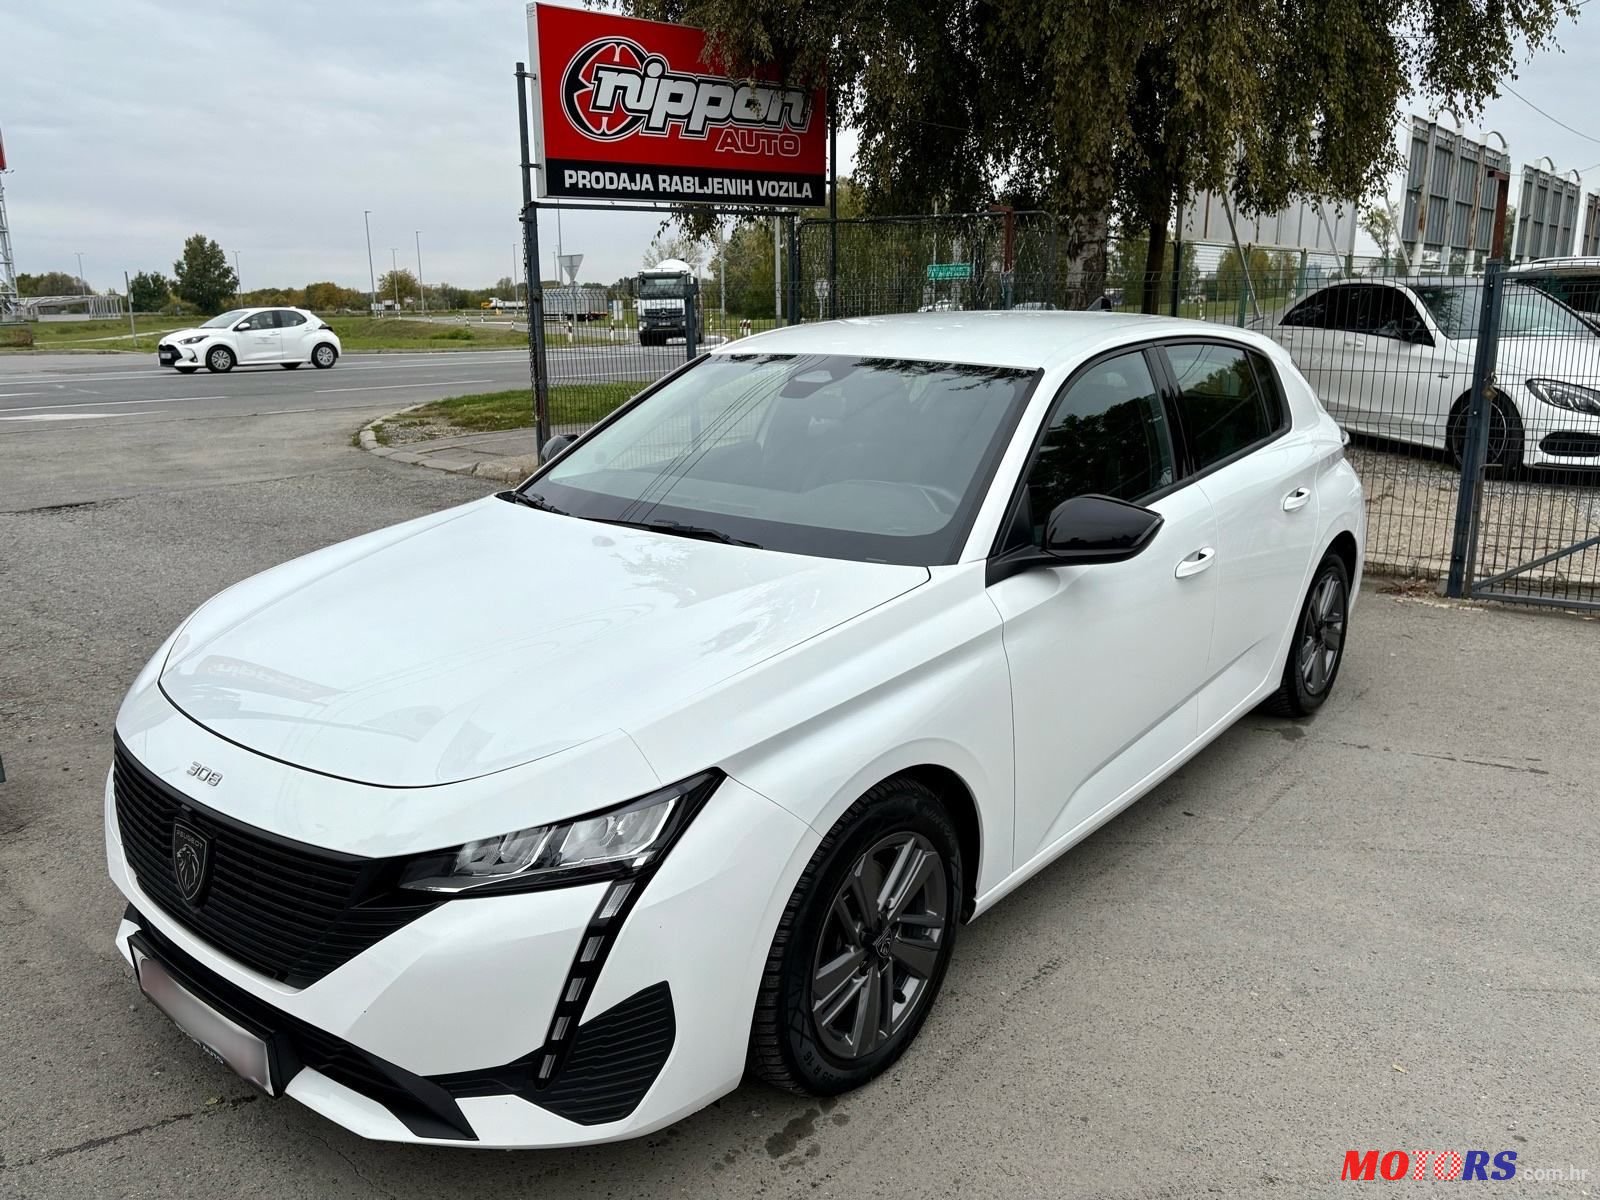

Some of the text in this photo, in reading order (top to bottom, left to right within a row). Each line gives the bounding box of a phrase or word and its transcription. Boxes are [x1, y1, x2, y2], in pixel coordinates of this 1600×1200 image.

[593, 57, 811, 137] nippon
[715, 129, 800, 156] AUTO
[564, 170, 813, 199] PRODAJA RABLJENIH VOZILA
[187, 762, 223, 787] 308
